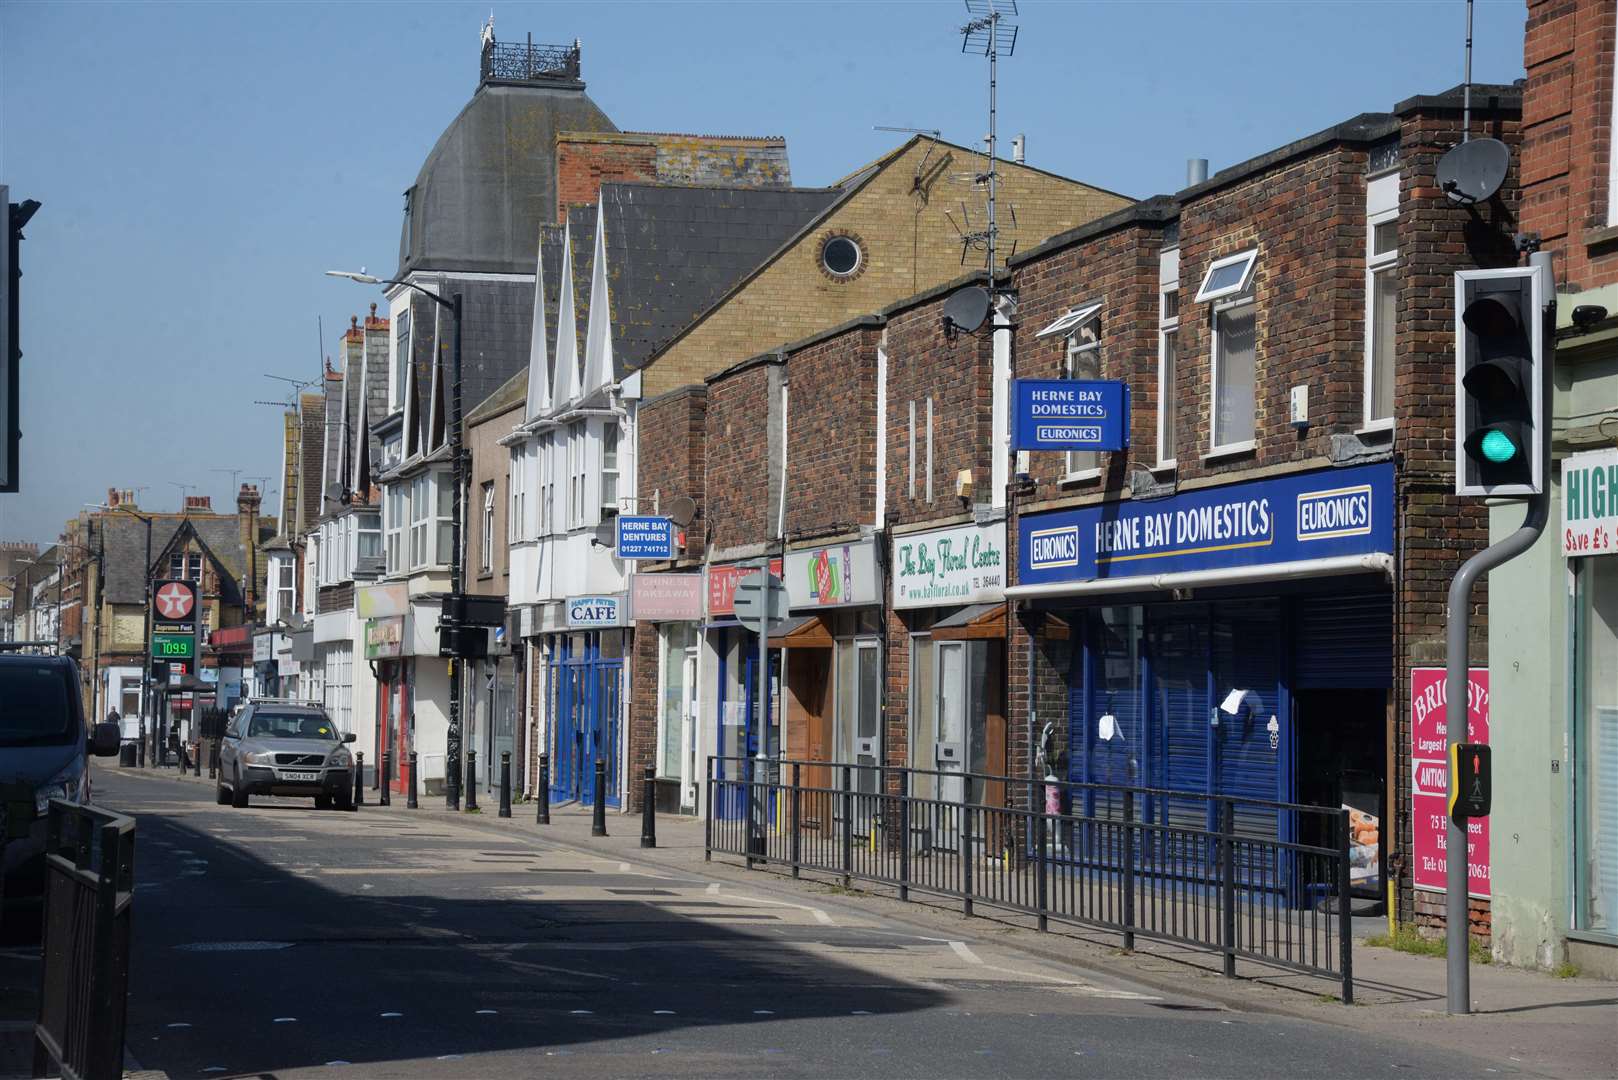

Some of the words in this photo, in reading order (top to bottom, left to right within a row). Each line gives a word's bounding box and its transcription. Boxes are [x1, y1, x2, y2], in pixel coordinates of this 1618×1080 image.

[1032, 391, 1074, 401] HERNE
[1079, 391, 1103, 402] BAY
[1032, 404, 1104, 415] DOMESTICS
[1041, 429, 1097, 439] EURONICS
[1301, 496, 1367, 531] EURONICS
[621, 522, 650, 531] HERNE
[651, 522, 668, 531] BAY
[1096, 516, 1141, 553] HERNE
[1144, 512, 1173, 548] BAY
[1176, 498, 1269, 544] DOMESTICS
[623, 532, 667, 542] DENTURES
[1565, 528, 1589, 551] Save
[621, 545, 642, 553] 01227
[1033, 534, 1075, 561] EURONICS
[900, 544, 916, 577] The
[918, 542, 936, 588] Bay
[937, 536, 969, 579] Floral
[972, 534, 1000, 569] Centre
[637, 590, 696, 599] TAKEAWAY
[571, 606, 617, 620] CAFE
[1418, 737, 1442, 754] Largest
[1430, 815, 1439, 829] 75
[1422, 856, 1437, 871] Tel:
